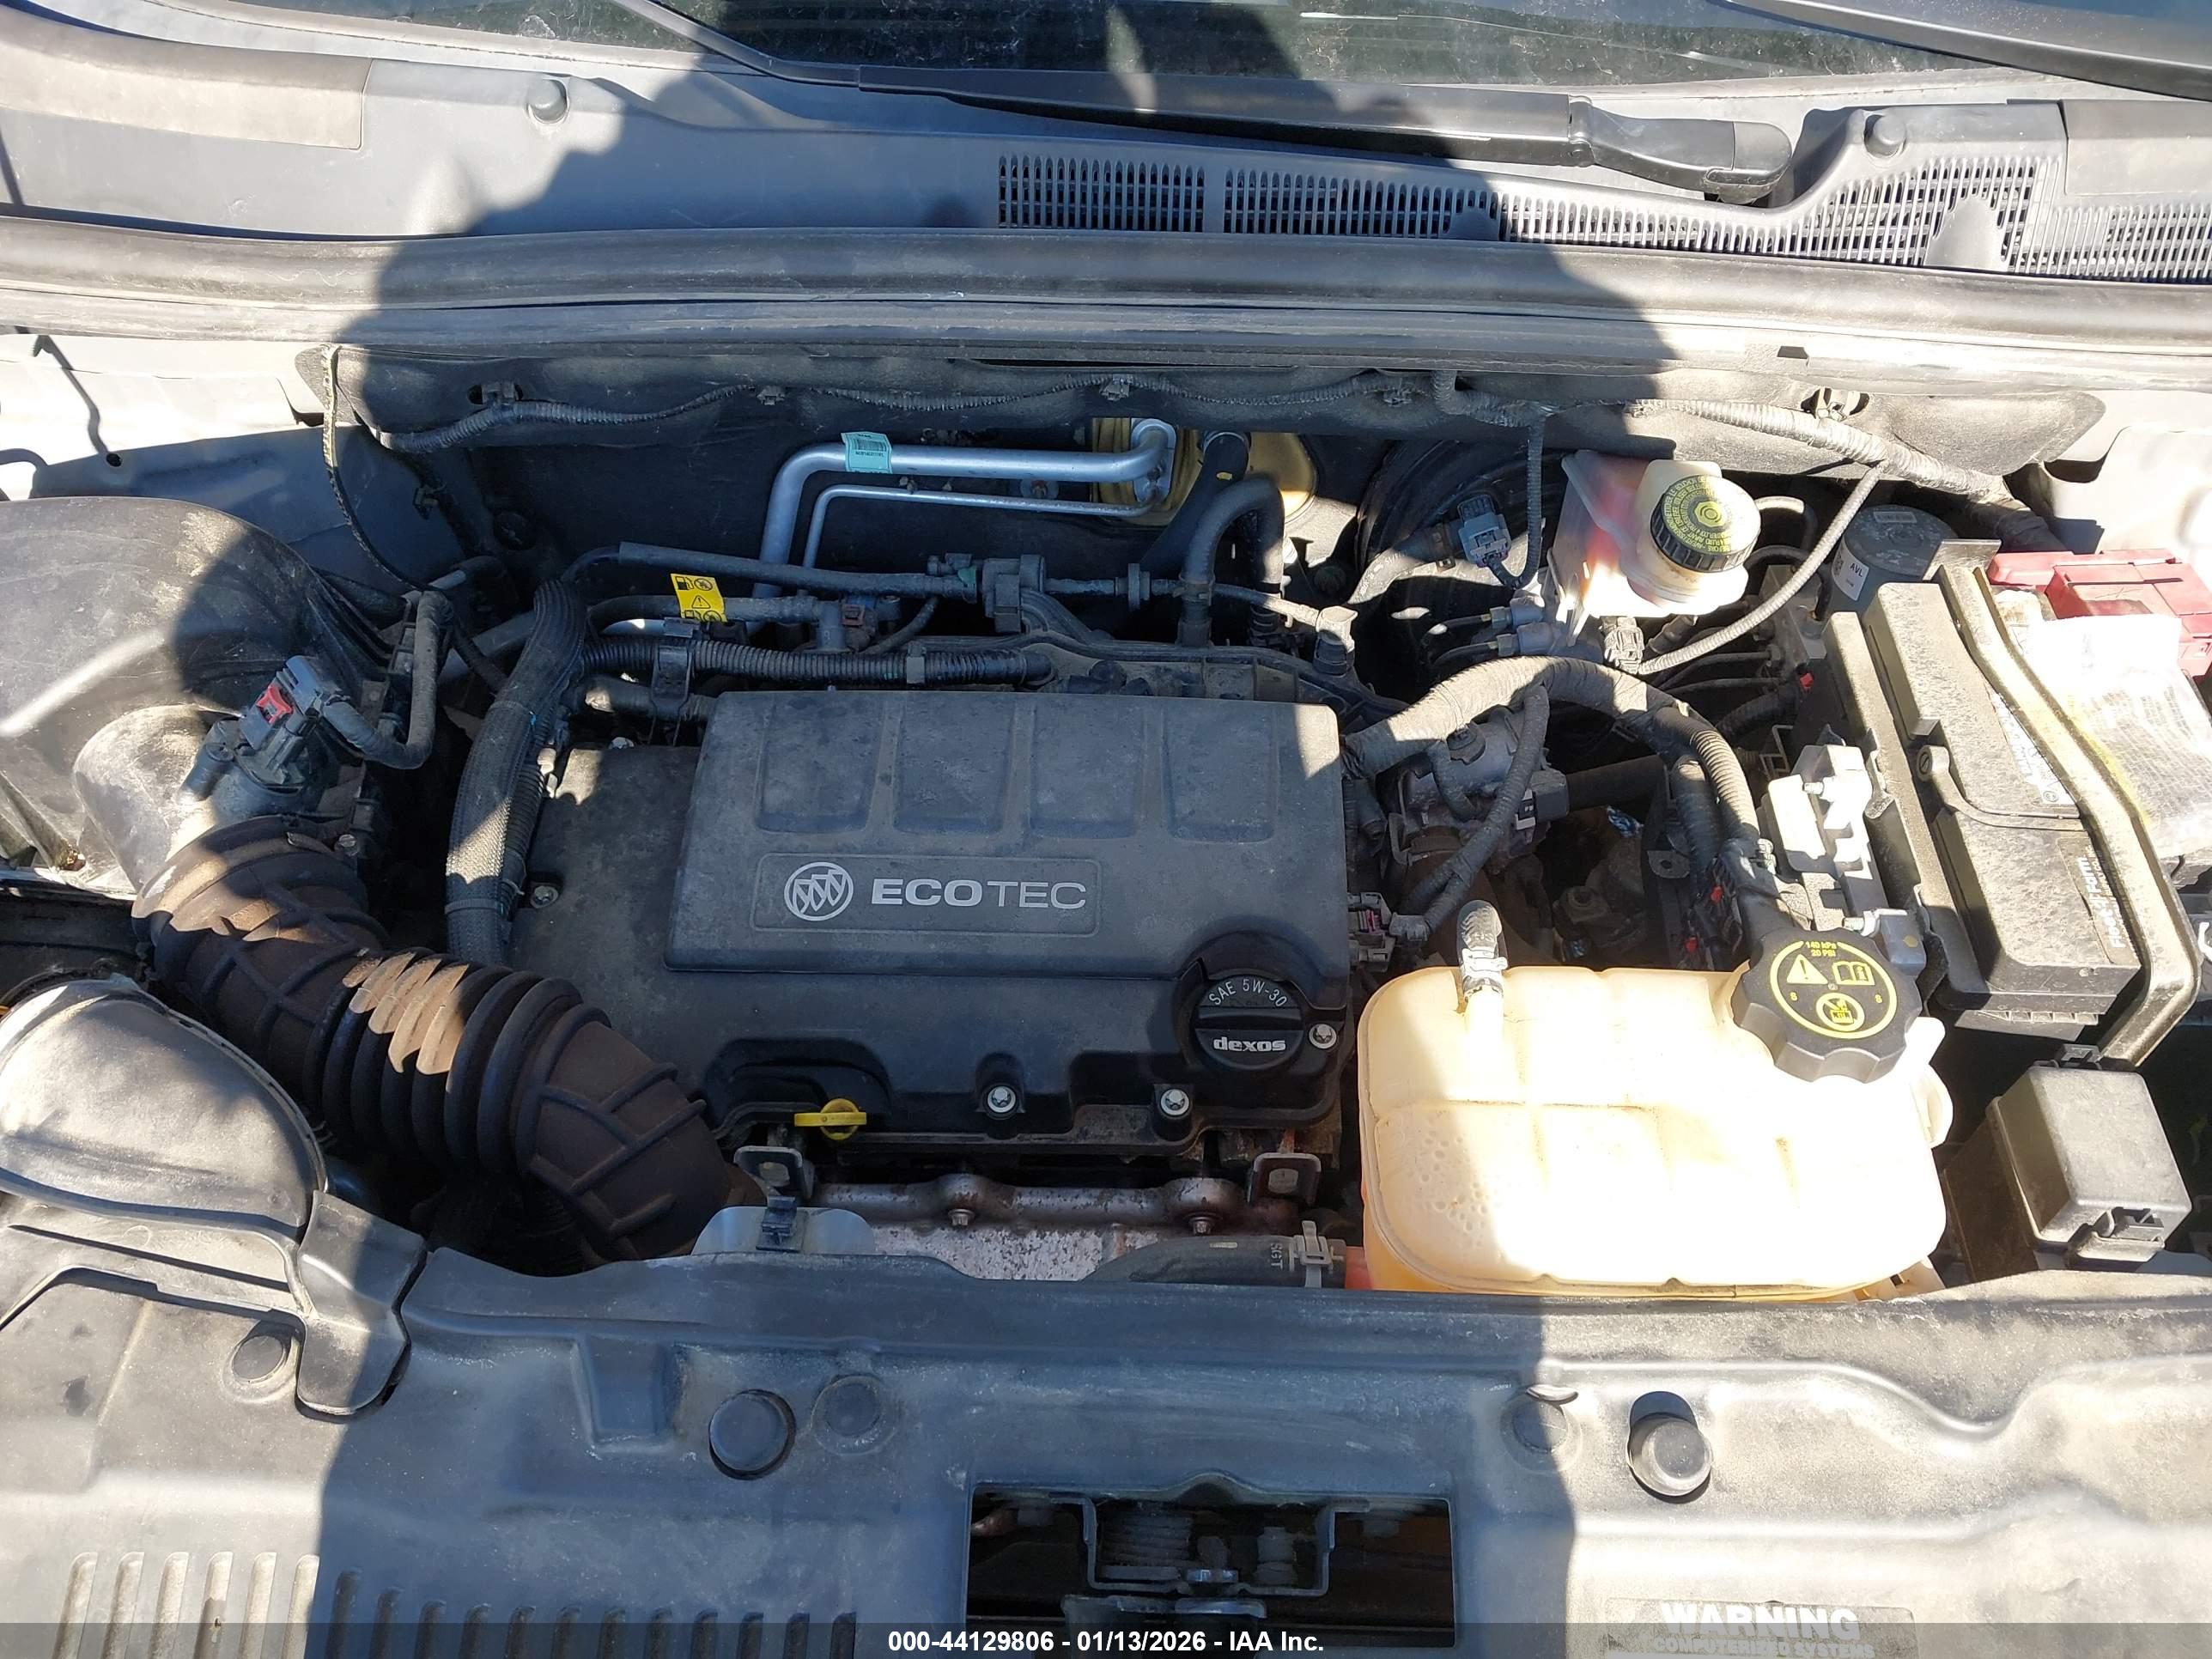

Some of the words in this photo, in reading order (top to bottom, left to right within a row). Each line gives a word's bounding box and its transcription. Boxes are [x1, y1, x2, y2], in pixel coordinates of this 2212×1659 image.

[1850, 562, 1863, 578] AVL
[871, 878, 1087, 909] ECOTEC
[1209, 981, 1237, 1006] SAE
[1243, 979, 1287, 1007] 5W-30
[1213, 1036, 1286, 1052] dexos
[1660, 1602, 1861, 1640] WARNING
[1656, 1637, 1787, 1655] COMPUTERIZED
[1794, 1642, 1875, 1659] SYSTEMS
